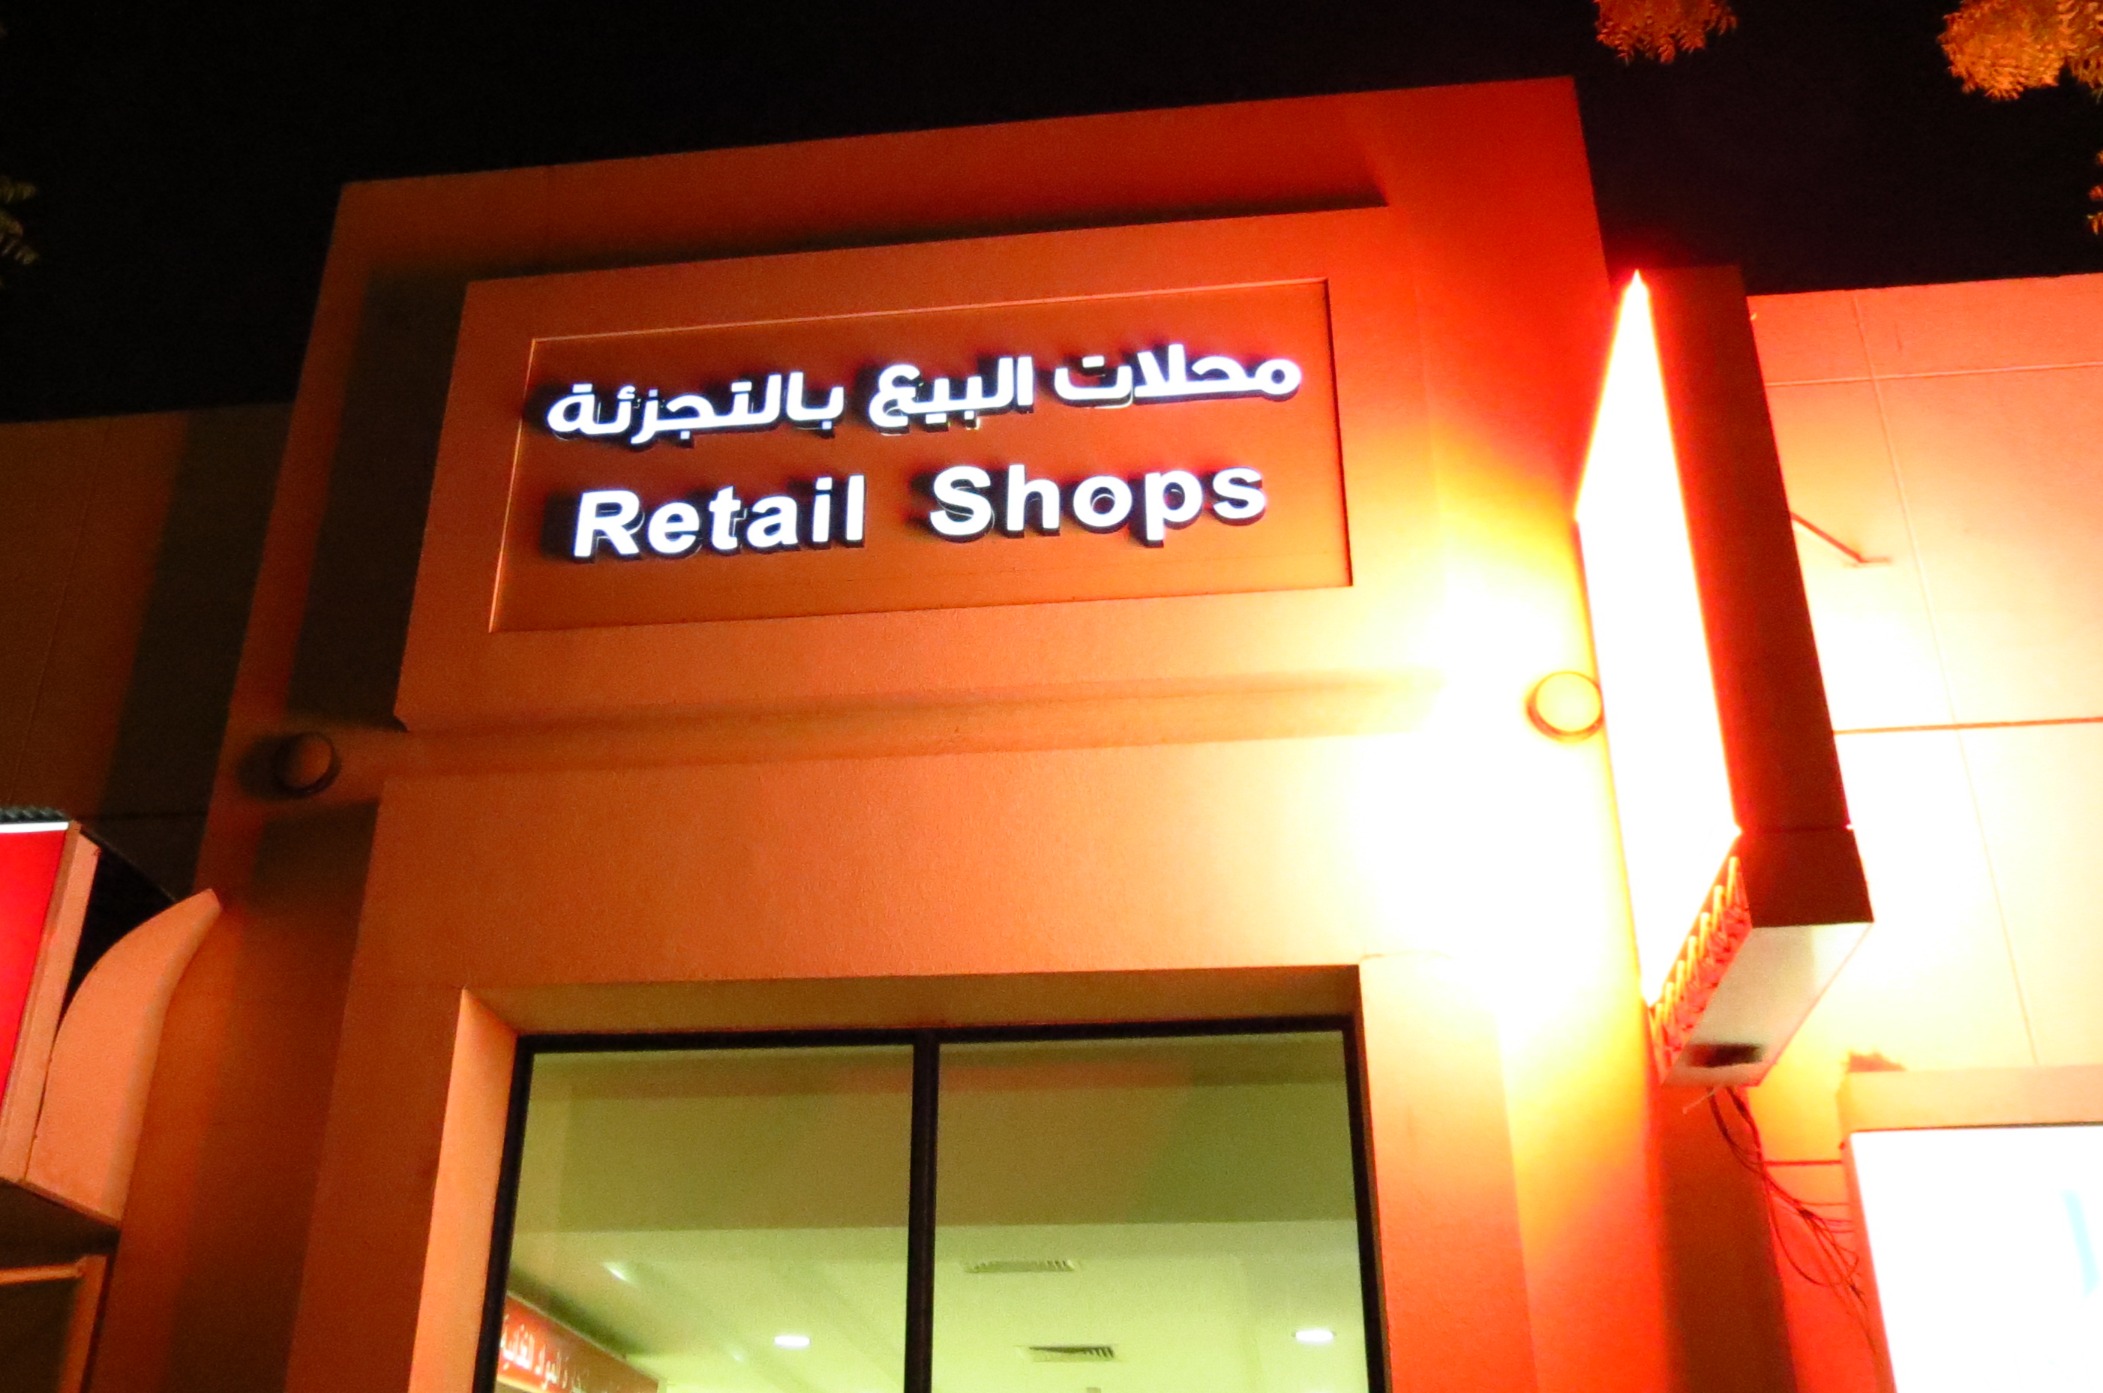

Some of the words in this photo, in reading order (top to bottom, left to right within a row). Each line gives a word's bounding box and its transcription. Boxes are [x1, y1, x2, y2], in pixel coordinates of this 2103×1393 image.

[547, 371, 845, 445] بالتجزئة
[868, 355, 1035, 429] البيع
[1053, 342, 1303, 410] محلات
[574, 474, 866, 558] Retail
[930, 463, 1269, 543] Shops
